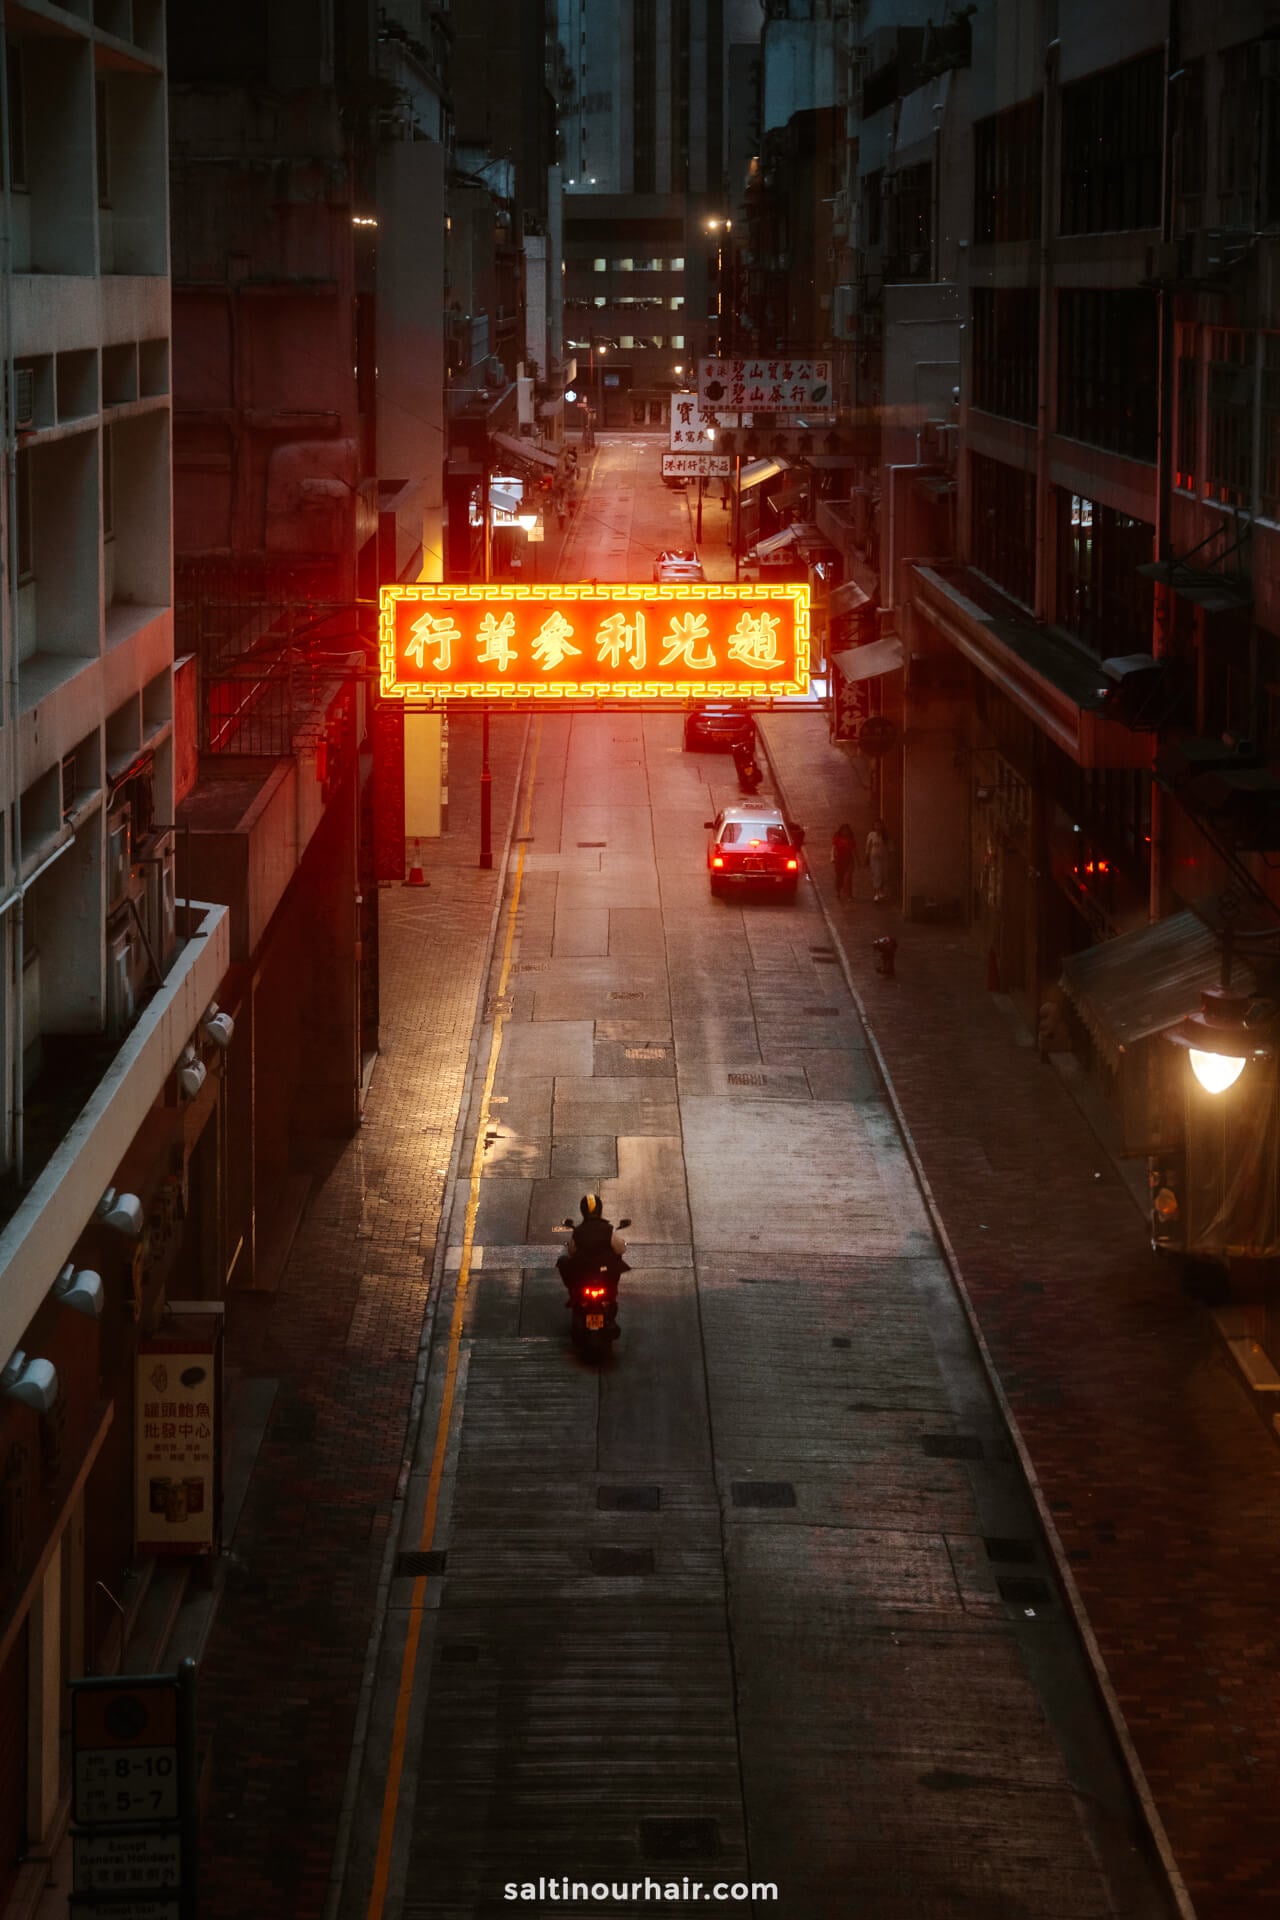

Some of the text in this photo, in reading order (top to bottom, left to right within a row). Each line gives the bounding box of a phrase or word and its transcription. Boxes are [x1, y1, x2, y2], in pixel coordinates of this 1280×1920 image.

[730, 383, 807, 404] 碧山茶行
[144, 1422, 210, 1439] 批發中心
[115, 1755, 172, 1778] 8-10
[80, 1852, 176, 1867] General Holidays
